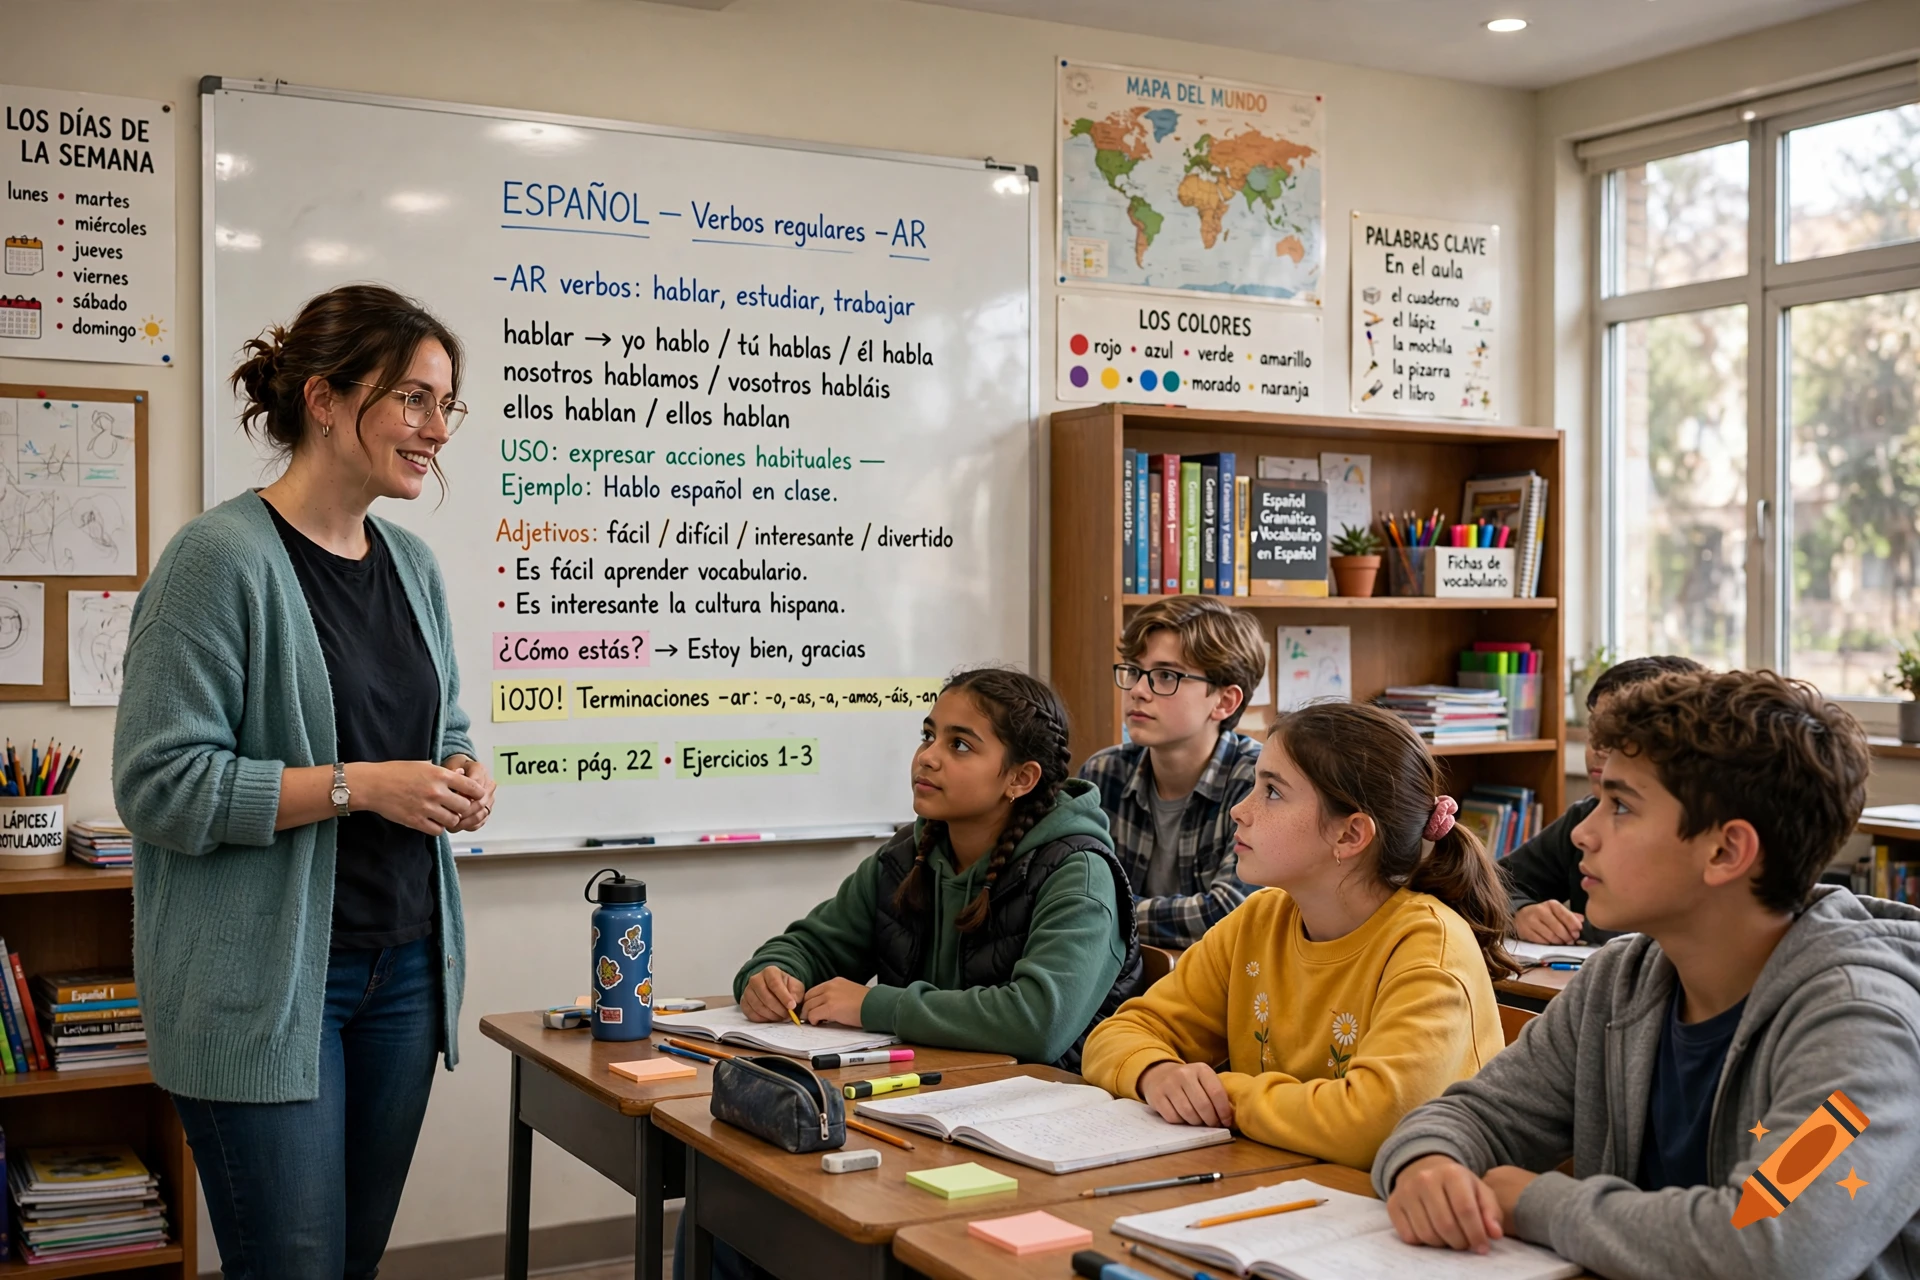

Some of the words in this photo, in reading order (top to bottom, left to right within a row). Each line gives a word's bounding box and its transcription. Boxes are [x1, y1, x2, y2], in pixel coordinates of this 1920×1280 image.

[1127, 77, 1170, 99] MAPA
[1178, 83, 1204, 104] DEL
[1212, 88, 1267, 113] MUNDO
[7, 106, 49, 133] LOS
[60, 107, 111, 138] DÍAS
[122, 118, 149, 142] DE
[22, 140, 49, 164] LA
[59, 143, 154, 173] SEMANA
[8, 180, 48, 202] lunes
[76, 191, 129, 208] martes
[76, 216, 146, 235] miércoles
[504, 181, 649, 224] ESPAÑOL
[692, 201, 764, 233] Verbos
[775, 214, 865, 247] regulares
[72, 241, 122, 262] jueves
[1366, 226, 1438, 251] PALABRAS
[1444, 234, 1485, 255] CLAVE
[73, 268, 128, 285] viernes
[1386, 253, 1403, 273] En
[1412, 256, 1424, 276] el
[1432, 259, 1462, 279] aula
[73, 292, 127, 311] sábado
[560, 271, 639, 297] verbos:
[654, 274, 725, 309] hablar,
[737, 284, 824, 315] estudiar,
[834, 290, 915, 324] trabajar
[1392, 286, 1401, 302] el
[1407, 290, 1459, 307] cuaderno
[73, 317, 136, 343] domingo
[1140, 309, 1170, 330] LOS
[1178, 312, 1251, 336] COLORES
[1393, 311, 1402, 327] el
[1409, 312, 1435, 334] lápiz
[505, 318, 574, 346] hablar
[622, 335, 645, 358] yo
[657, 327, 709, 353] hablo
[738, 334, 759, 355] tú
[770, 333, 831, 360] hablas
[858, 340, 872, 362] él
[884, 340, 933, 365] habla
[1095, 339, 1121, 361] rojo
[1145, 341, 1172, 358] azul
[1198, 345, 1233, 362] verde
[1260, 351, 1311, 368] amarillo
[1394, 335, 1403, 351] la
[1409, 338, 1452, 354] mochila
[504, 361, 592, 384] nosotros
[605, 361, 698, 389] hablamos
[728, 372, 811, 394] vosotros
[822, 372, 890, 398] habláis
[1393, 359, 1403, 374] la
[1409, 363, 1450, 380] pizarra
[1192, 375, 1240, 392] morado
[1262, 384, 1309, 403] naranja
[1393, 384, 1403, 399] el
[1409, 384, 1435, 401] libro
[504, 394, 553, 420] ellos
[566, 396, 635, 422] hablan
[666, 401, 712, 425] ellos
[724, 403, 789, 428] hablan
[502, 439, 556, 462] USO:
[570, 449, 655, 471] expresar
[666, 447, 745, 466] acciones
[757, 445, 851, 470] habituales
[503, 473, 590, 504] Ejemplo:
[605, 475, 660, 498] Hablo
[671, 477, 741, 506] español
[753, 487, 774, 500] en
[785, 479, 837, 501] clase.
[496, 519, 596, 550] Adjetivos:
[607, 520, 649, 543] fácil
[676, 522, 728, 544] difícil
[756, 525, 853, 546] interesante
[878, 525, 953, 547] divertido
[517, 558, 540, 580] Es
[550, 557, 593, 580] fácil
[605, 558, 688, 588] aprender
[698, 559, 806, 580] vocabulario.
[1448, 555, 1482, 570] Fichas
[1488, 556, 1500, 569] de
[1443, 573, 1507, 587] vocabulario
[517, 592, 540, 614] Es
[552, 593, 658, 614] interesante
[670, 591, 685, 613] la
[696, 592, 761, 613] cultura
[771, 592, 844, 620] hispana.
[500, 636, 568, 662] ¿Cómo
[579, 636, 643, 659] estás?
[689, 638, 740, 667] Estoy
[751, 637, 792, 662] bien,
[802, 640, 865, 667] gracias
[501, 685, 562, 711] ¡OJO!
[577, 686, 709, 708] Terminaciones
[500, 752, 566, 775] Tarea:
[578, 752, 616, 781] pág.
[627, 750, 652, 770] 22
[684, 747, 768, 777] Ejercicios
[779, 745, 812, 766] 1-3
[3, 810, 47, 829] LÁPICES
